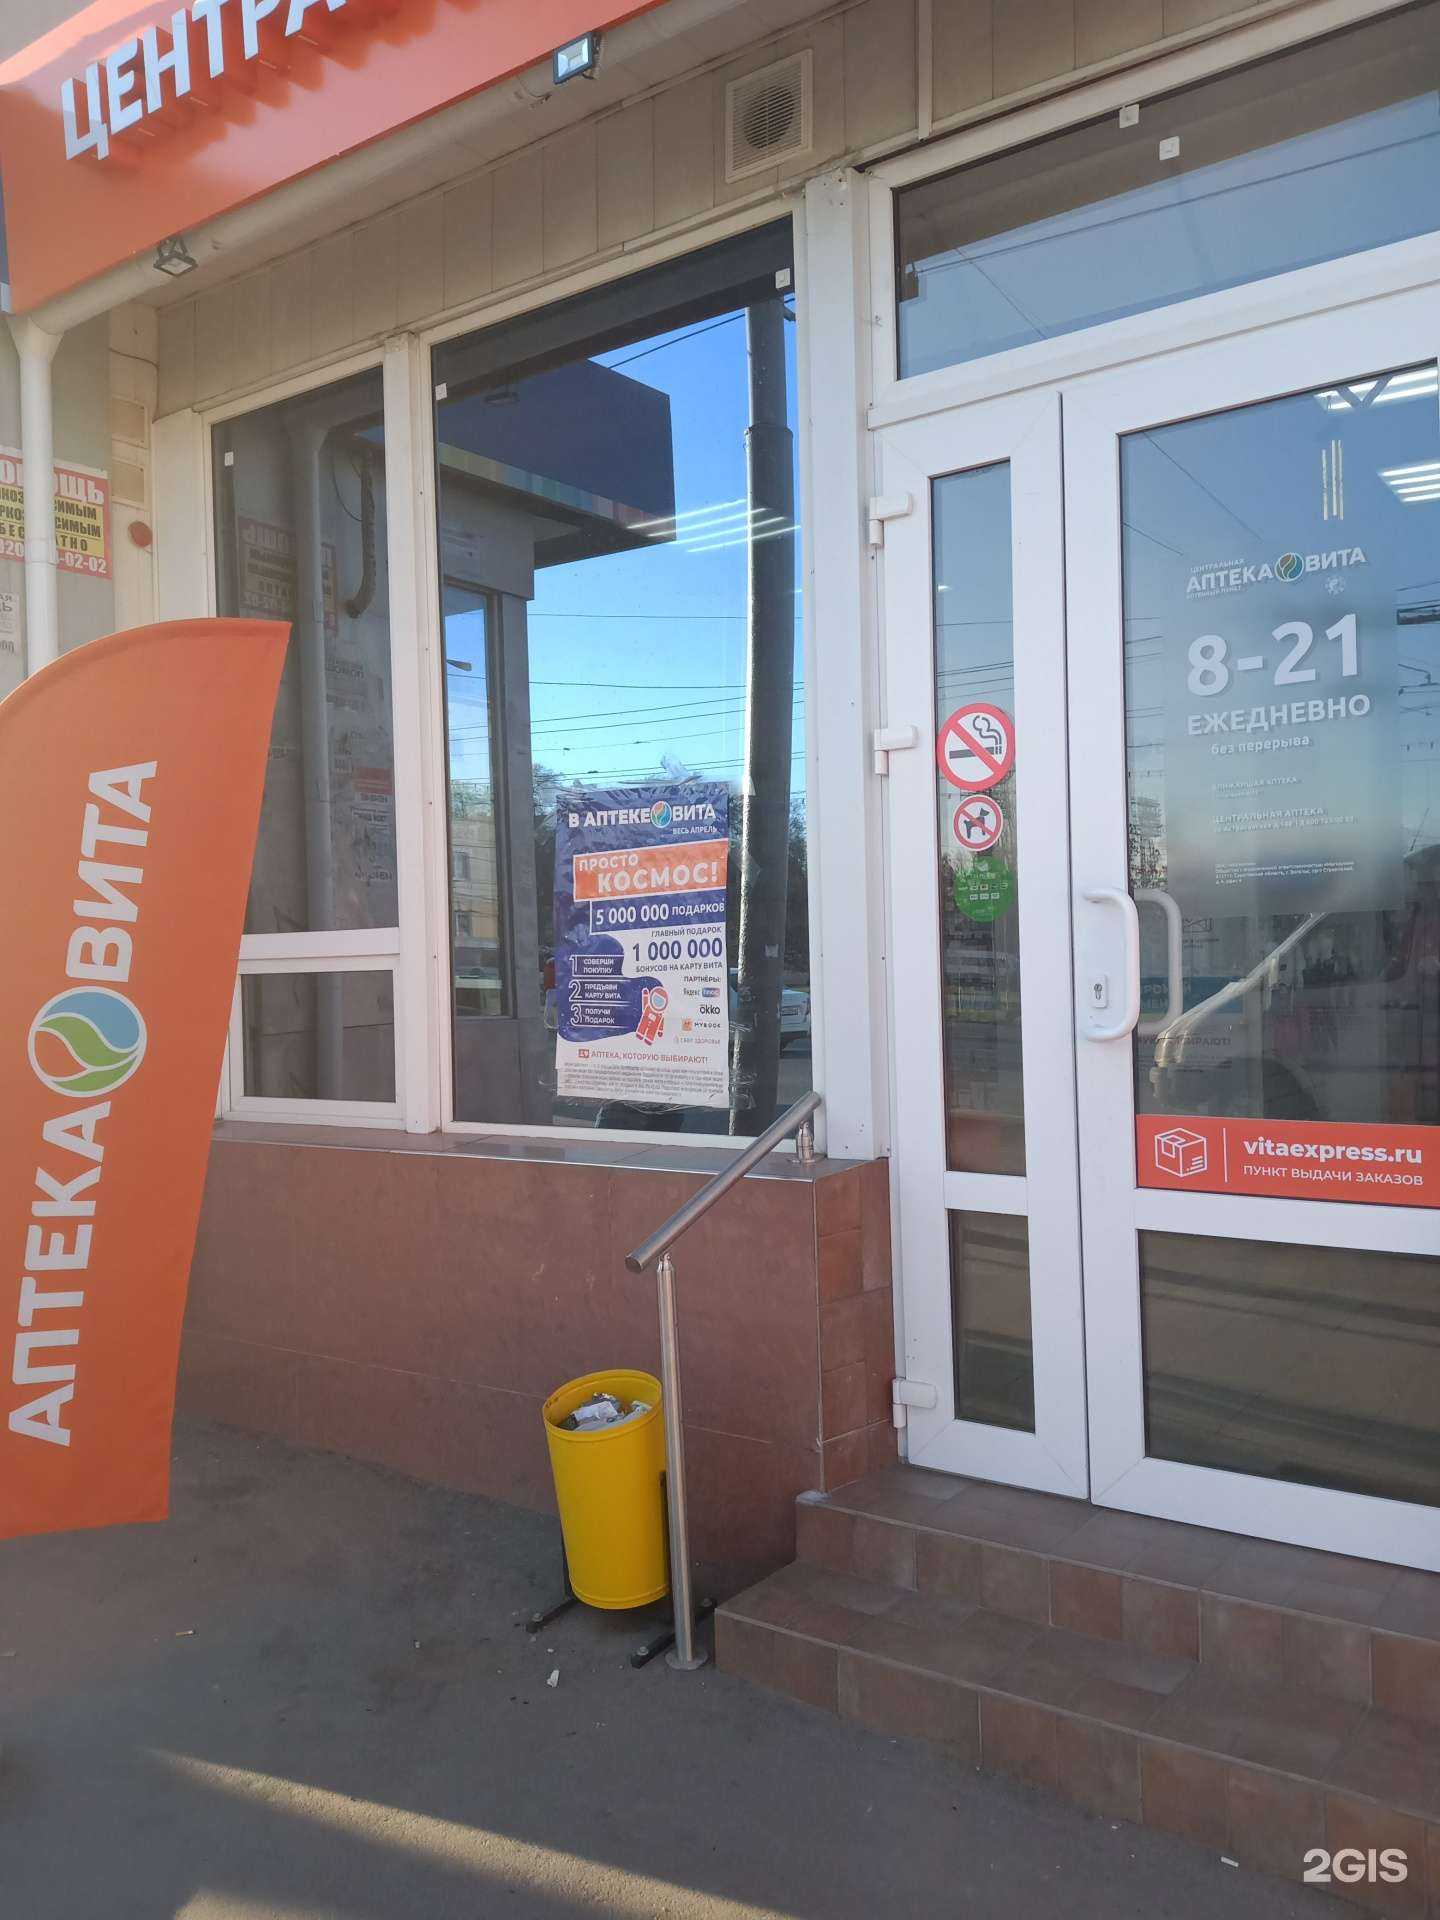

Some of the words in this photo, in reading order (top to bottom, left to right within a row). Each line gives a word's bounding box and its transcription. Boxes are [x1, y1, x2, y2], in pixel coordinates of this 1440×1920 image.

[1186, 563, 1274, 593] АПТЕКА
[1305, 547, 1367, 572] ВИТА
[1187, 613, 1358, 696] 8-21
[1187, 694, 1370, 735] ЕЖЕДНЕВНО
[1211, 742, 1234, 754] без
[1238, 736, 1310, 754] перерыва
[568, 813, 580, 828] В
[583, 807, 650, 828] АПТЕКЕ
[673, 803, 716, 821] ВИТА
[690, 825, 717, 835] АПРЕЛЬ
[579, 854, 639, 872] ПРОСТО
[598, 861, 719, 892] КОСМОС!
[595, 909, 604, 925] 5
[608, 906, 637, 923] 000
[640, 903, 670, 922] 000
[672, 902, 725, 917] ПОДАРКОВ
[651, 928, 685, 938] ГЛАВНЫЙ
[686, 926, 722, 936] ПОДАРОК
[632, 943, 640, 961] 1
[648, 940, 682, 961] 000
[687, 937, 723, 959] 000
[636, 964, 668, 973] БОНУСОВ
[669, 963, 679, 971] НА
[680, 962, 702, 970] КАРТУ
[703, 961, 723, 969] ВИТА
[585, 983, 618, 991] ПРЕДЪЯВИ
[585, 1016, 615, 1024] ПОДАРОК
[591, 1051, 622, 1061] АПТЕКА,
[622, 1052, 660, 1061] КОТОРУЮ
[661, 1054, 708, 1064] ВЫБИРАЮТ!
[8, 1101, 111, 1446] АПТЕКА
[65, 760, 158, 983] ВИТА
[1243, 1136, 1423, 1164] vitaexpress.ru
[1243, 1165, 1289, 1179] ПУНКТ
[1291, 1167, 1352, 1183] ВЫДАЧИ
[1355, 1171, 1424, 1186] ЗАКАЗОВ
